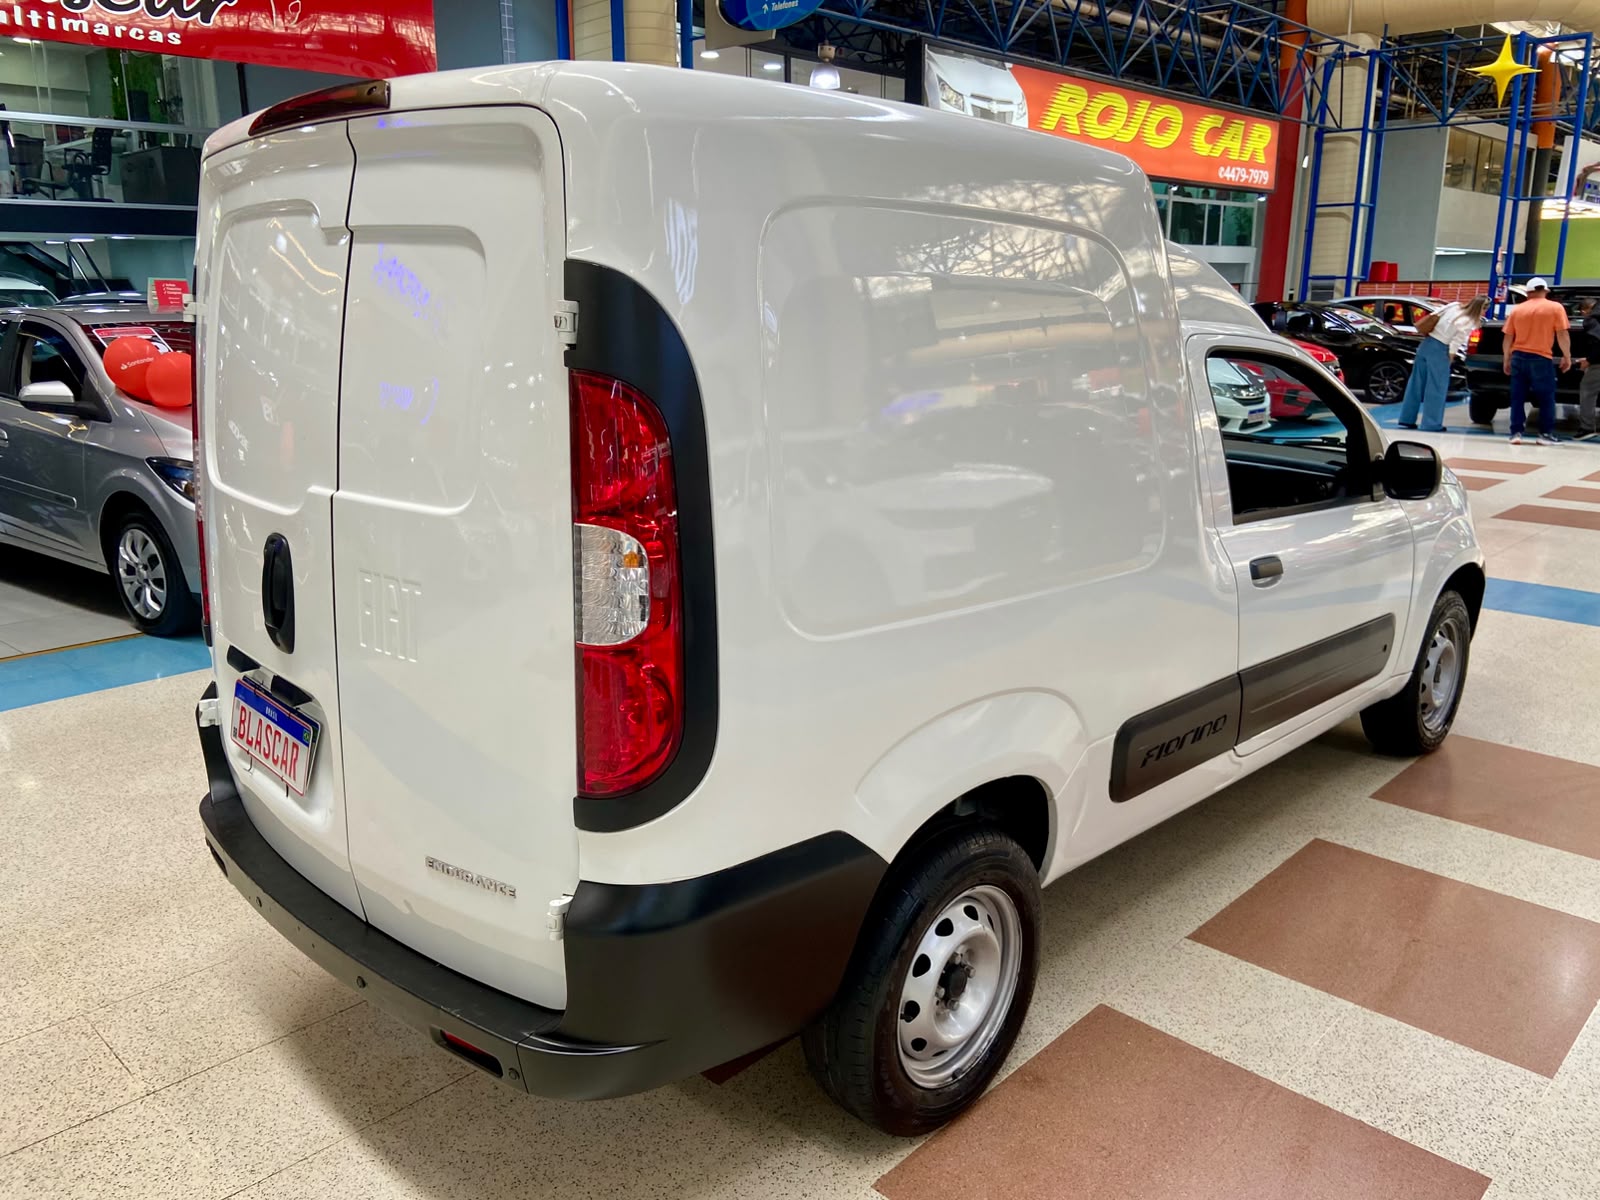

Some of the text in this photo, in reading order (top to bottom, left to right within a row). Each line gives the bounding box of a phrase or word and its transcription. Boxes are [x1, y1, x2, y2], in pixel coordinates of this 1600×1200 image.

[771, 0, 799, 11] Telefones
[1040, 83, 1272, 164] ROJO CAR
[1224, 166, 1270, 185] 4479-7979
[127, 357, 154, 368] Santander
[266, 706, 278, 722] BRASIL
[237, 705, 300, 782] BLASCAR
[425, 856, 516, 899] ENDURANCE
